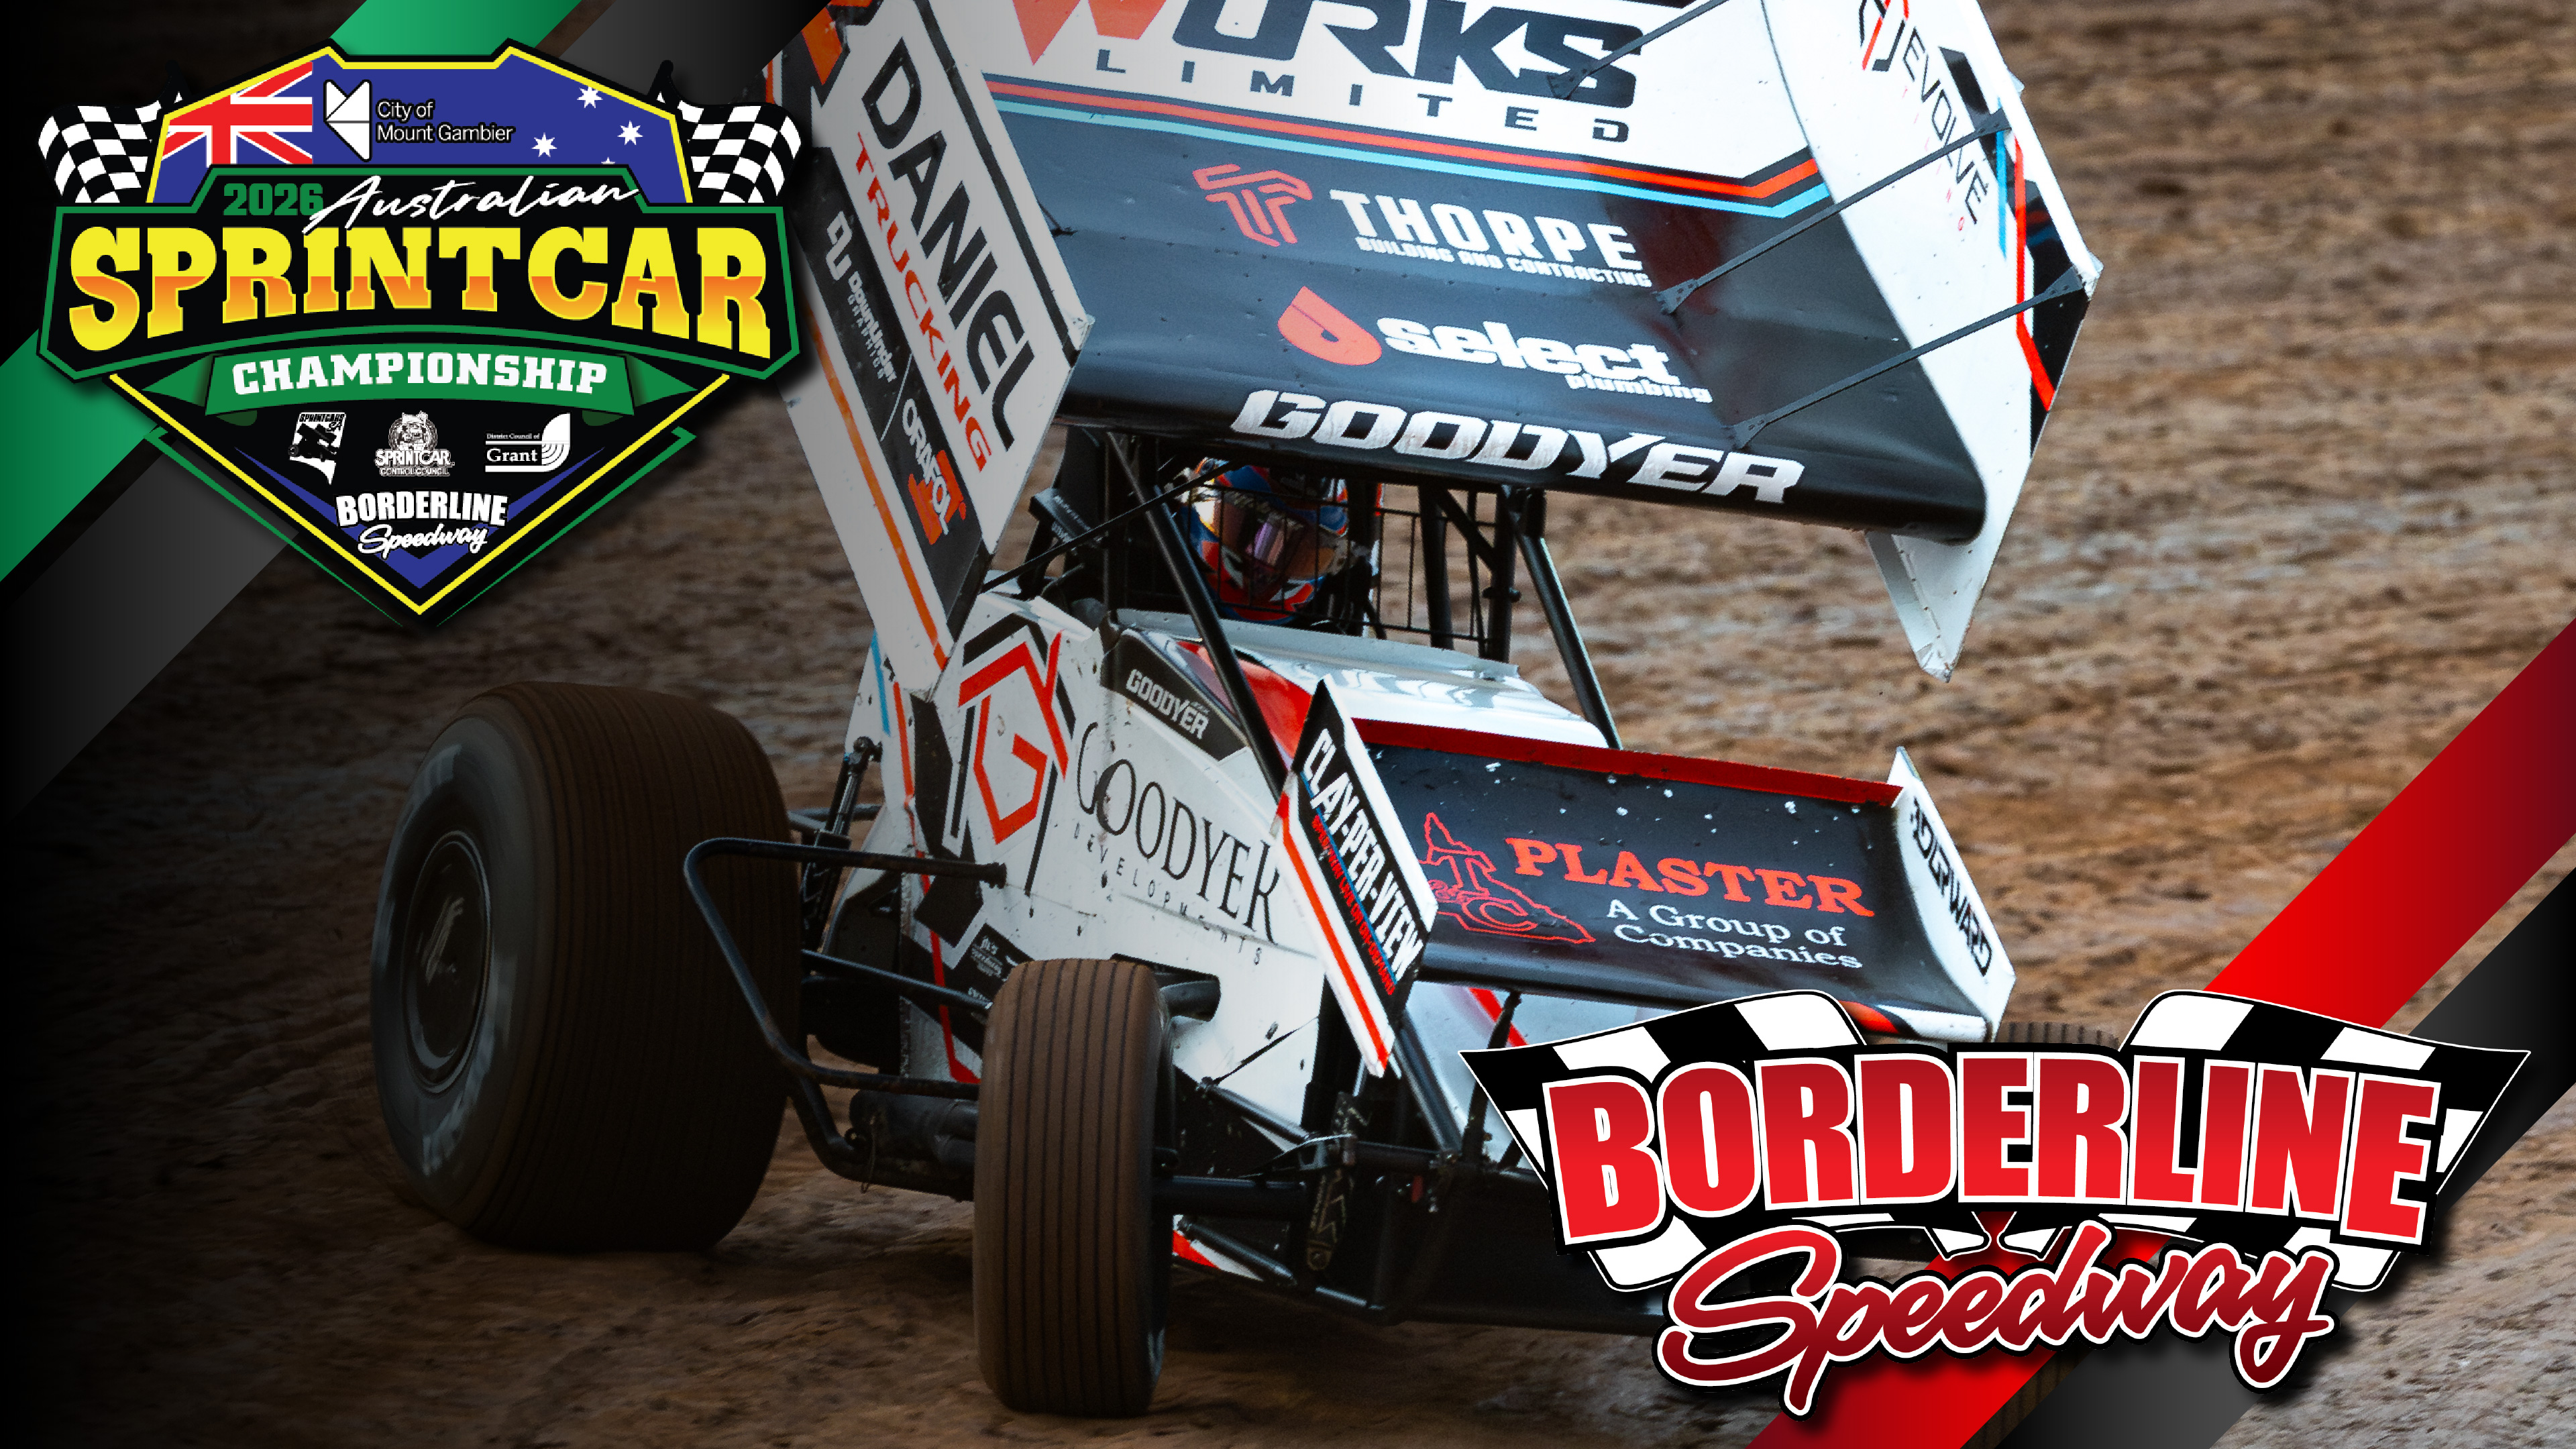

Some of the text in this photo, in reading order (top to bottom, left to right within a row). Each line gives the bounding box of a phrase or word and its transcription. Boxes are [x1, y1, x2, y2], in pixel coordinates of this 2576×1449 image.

[1096, 49, 1629, 143] LIMITED
[1902, 26, 1989, 225] EVOLVE
[861, 36, 1035, 451] DANIEL
[1329, 189, 1644, 271] THORPE
[1355, 236, 1653, 288] BUILDING AND CONTRACTING
[848, 276, 896, 382] DownUnder
[856, 131, 991, 471] TRUCKING
[1377, 317, 1682, 387] select
[1566, 374, 1713, 403] plumbing
[902, 398, 949, 535] ORAFOL
[1230, 389, 1805, 504] GOODYER
[1126, 669, 1209, 739] GOODYER
[1077, 722, 1280, 945] GOODYER
[1302, 729, 1424, 982] CLAY-PER-VIEW
[1505, 837, 1875, 917] PLASTER
[1607, 898, 1847, 947] A Group of
[1613, 924, 1863, 969] Companies
